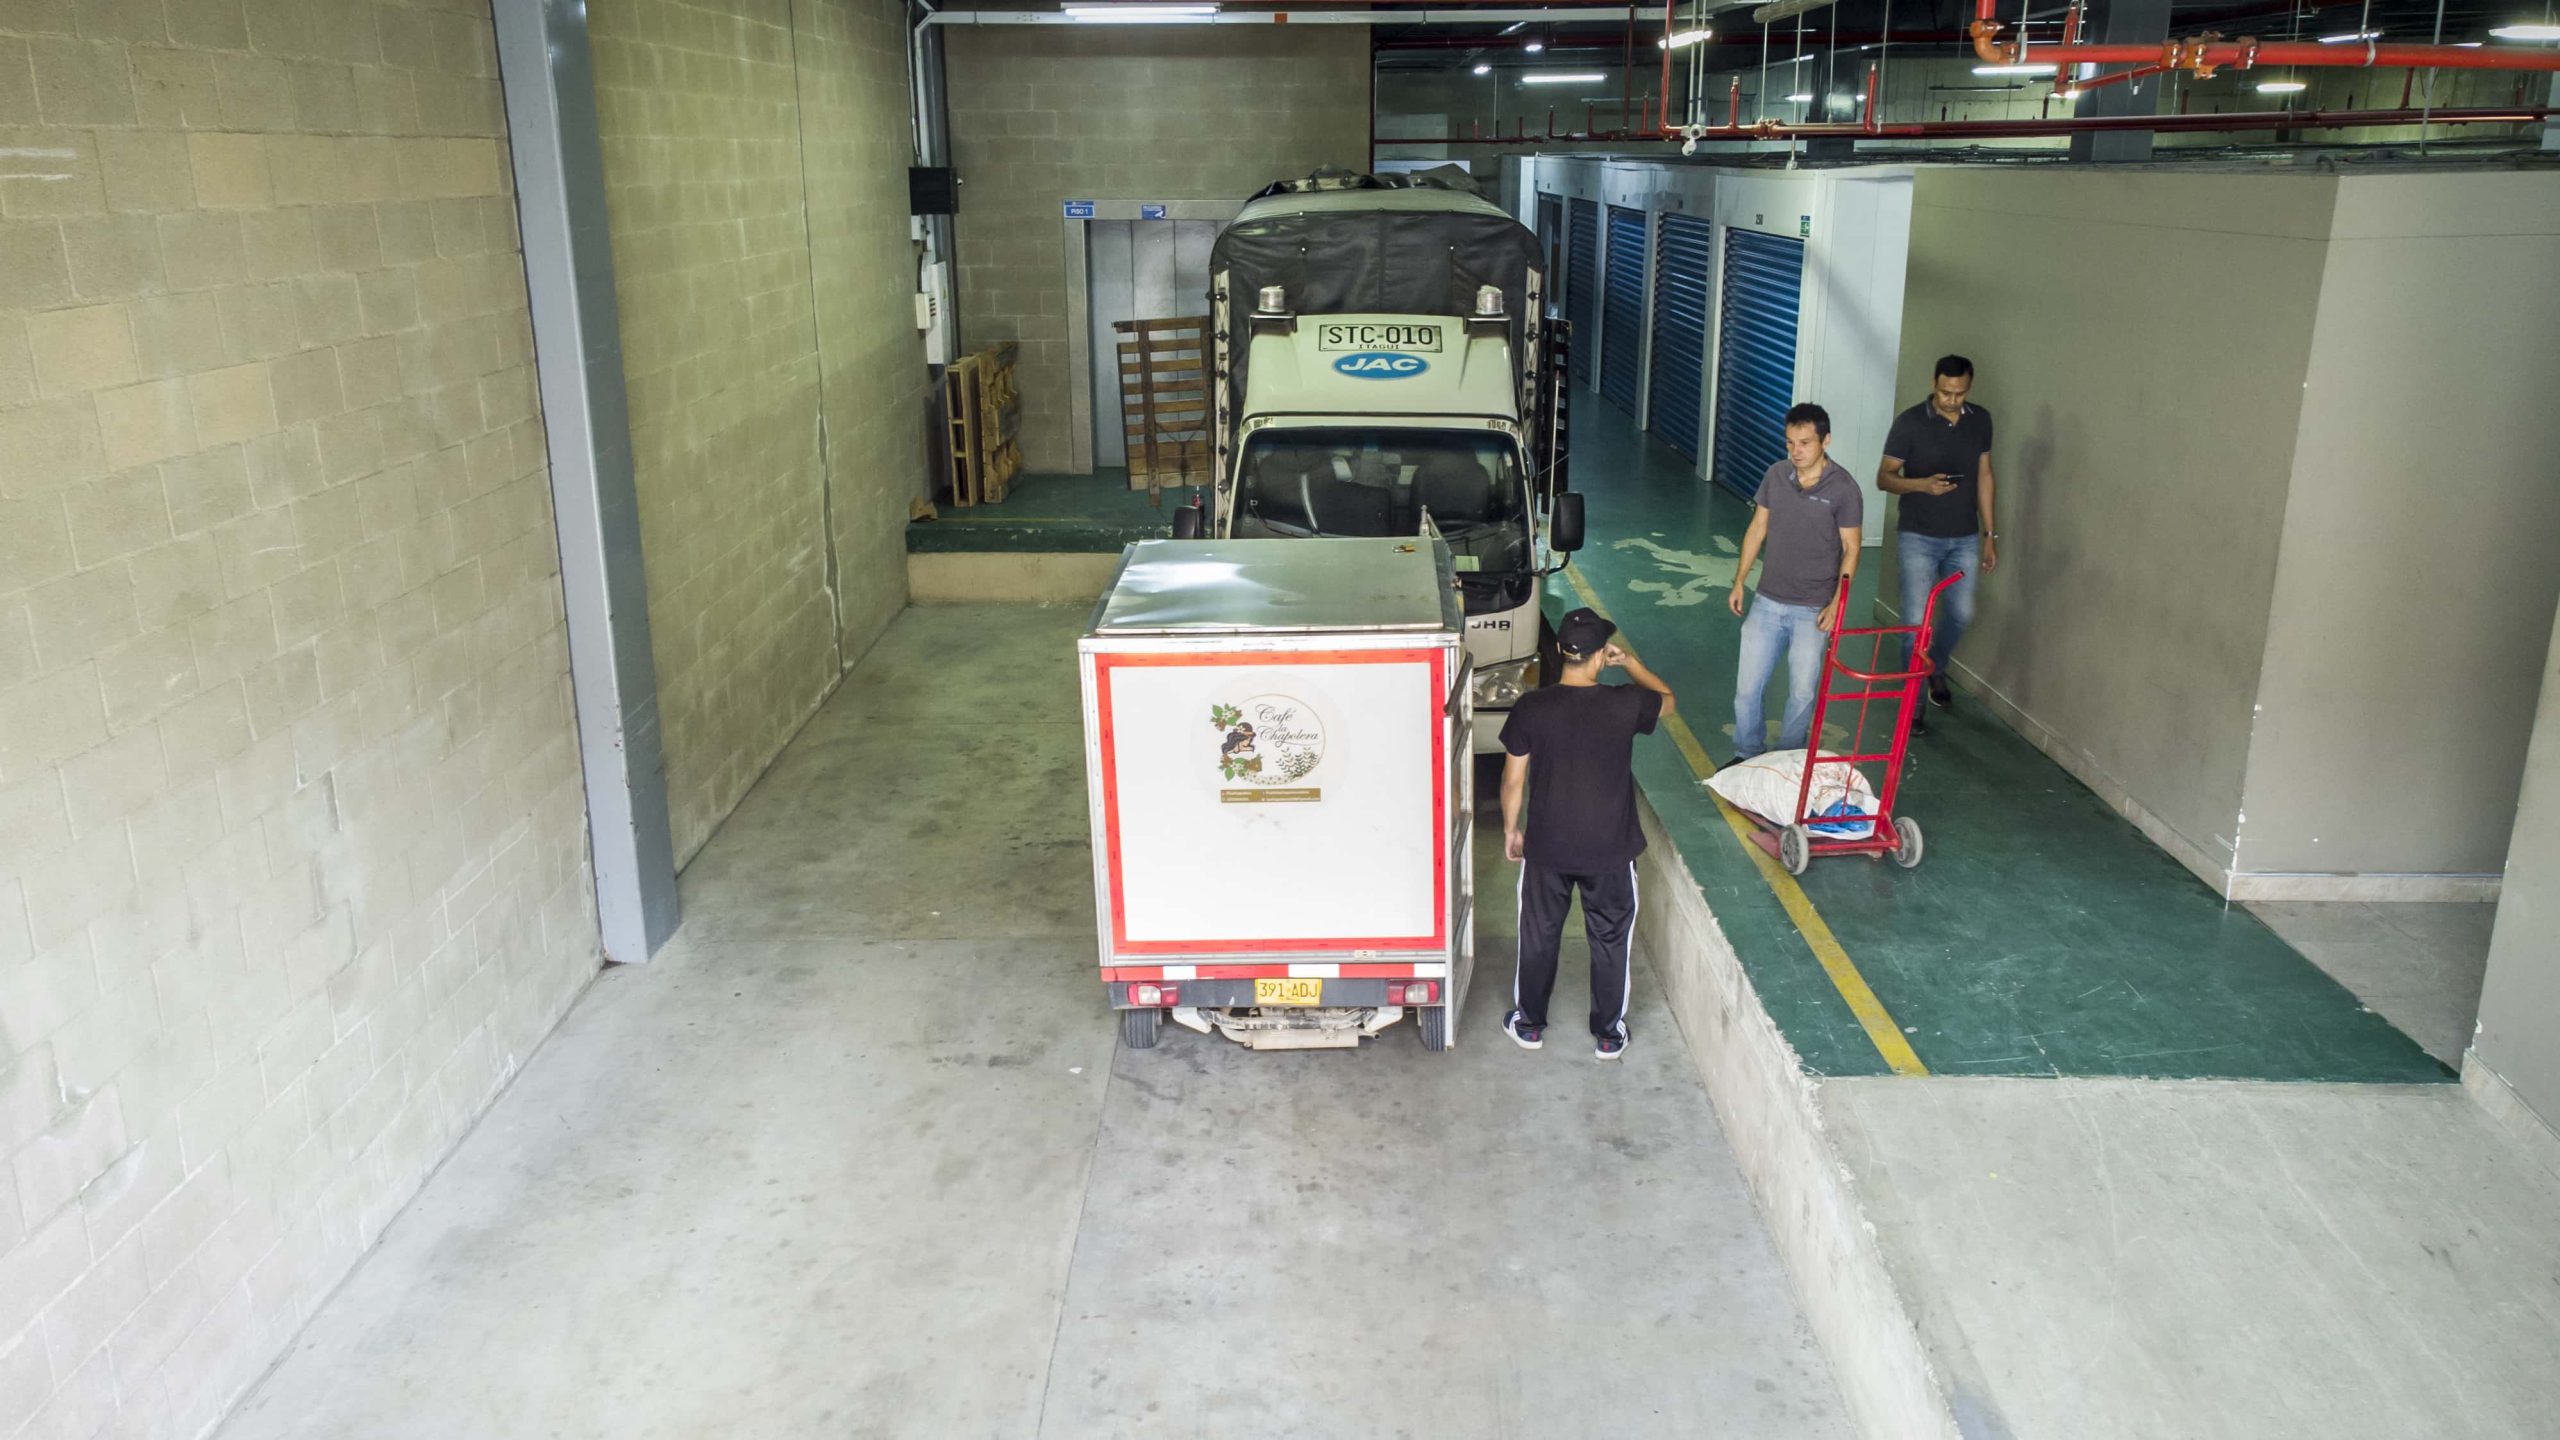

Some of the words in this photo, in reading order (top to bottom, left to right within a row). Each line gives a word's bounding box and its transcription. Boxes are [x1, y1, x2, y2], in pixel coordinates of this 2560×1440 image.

[1328, 326, 1434, 345] STC-010
[1341, 358, 1419, 371] JAC
[1255, 703, 1297, 723] Café
[1257, 725, 1319, 747] Chapolera
[1278, 723, 1288, 732] la
